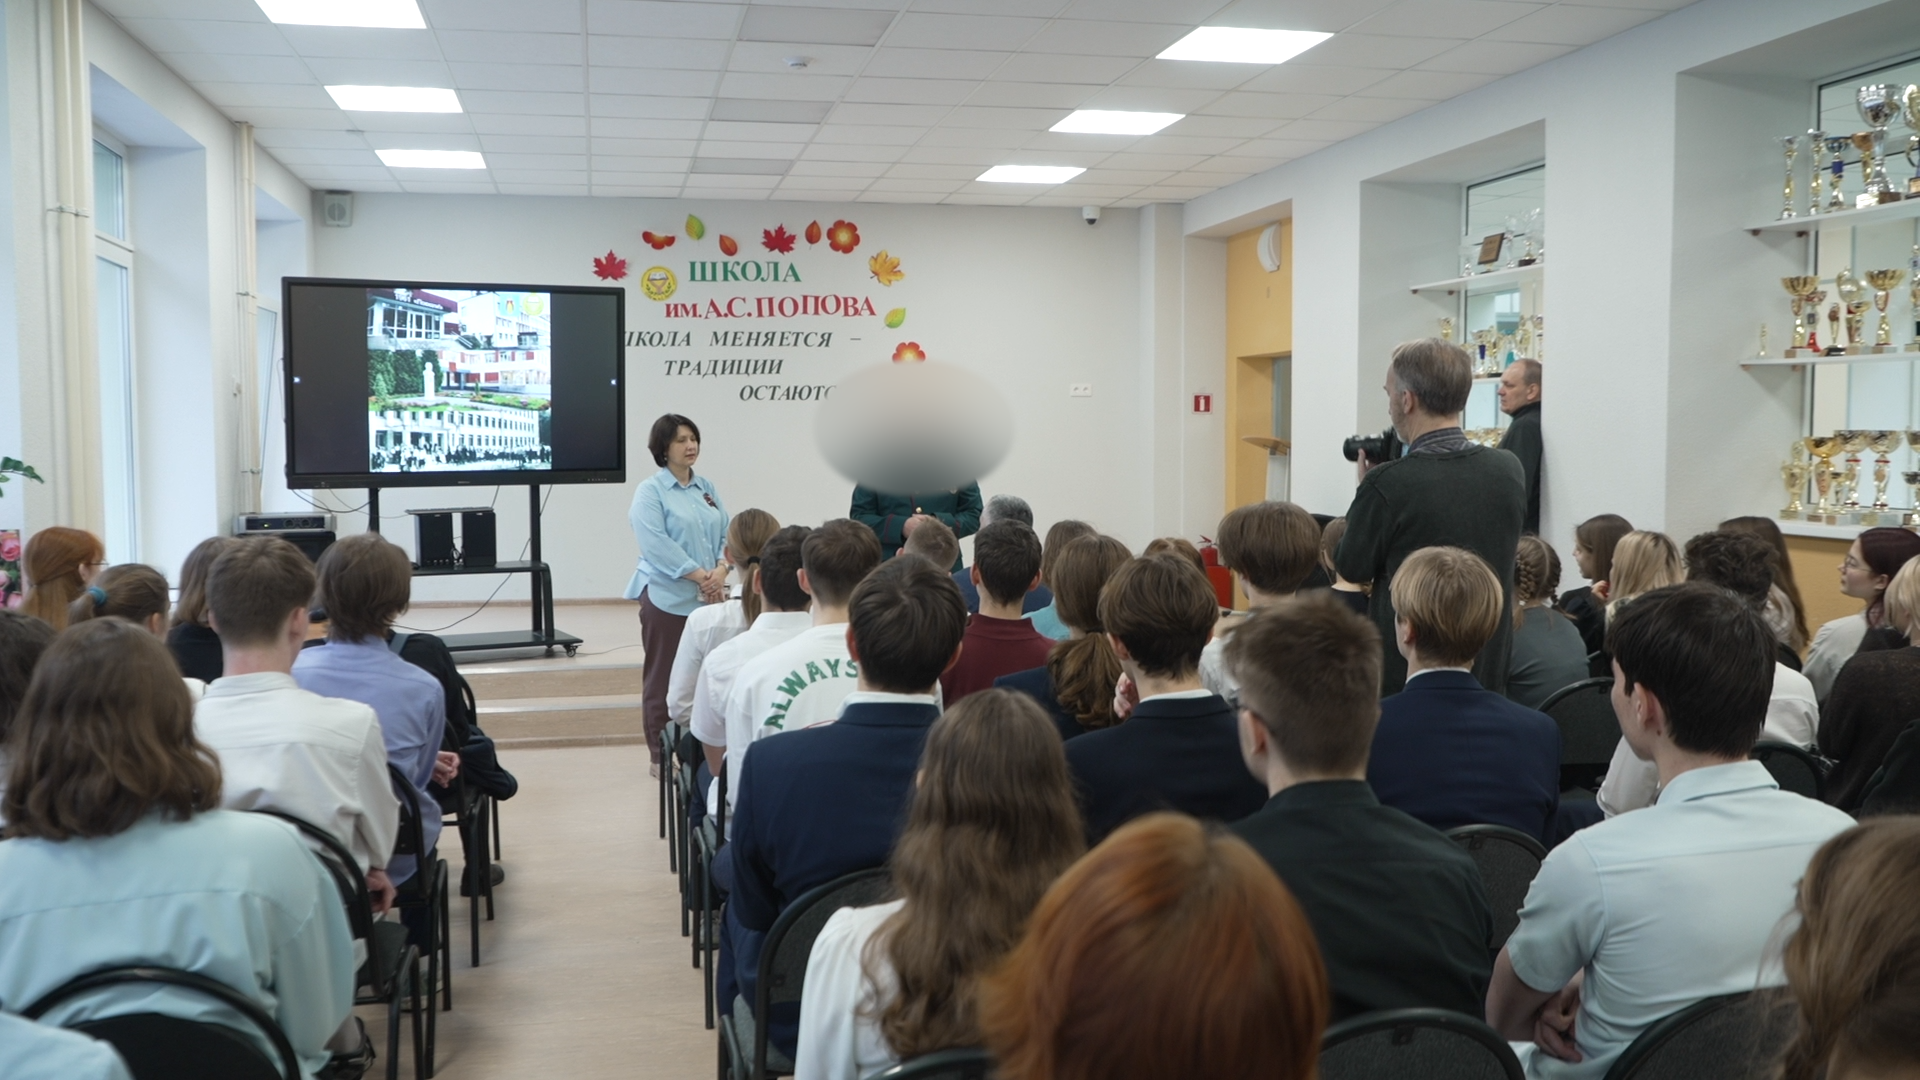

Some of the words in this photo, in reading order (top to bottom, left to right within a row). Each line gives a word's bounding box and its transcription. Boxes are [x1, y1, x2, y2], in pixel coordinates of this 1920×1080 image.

[688, 260, 802, 283] ШКОЛА
[709, 331, 833, 348] МЕНЯЕТСЯ
[664, 359, 784, 378] ТРАДИЦИИ
[739, 384, 837, 402] ОСТАЮТС
[764, 658, 858, 730] ALWAYS
